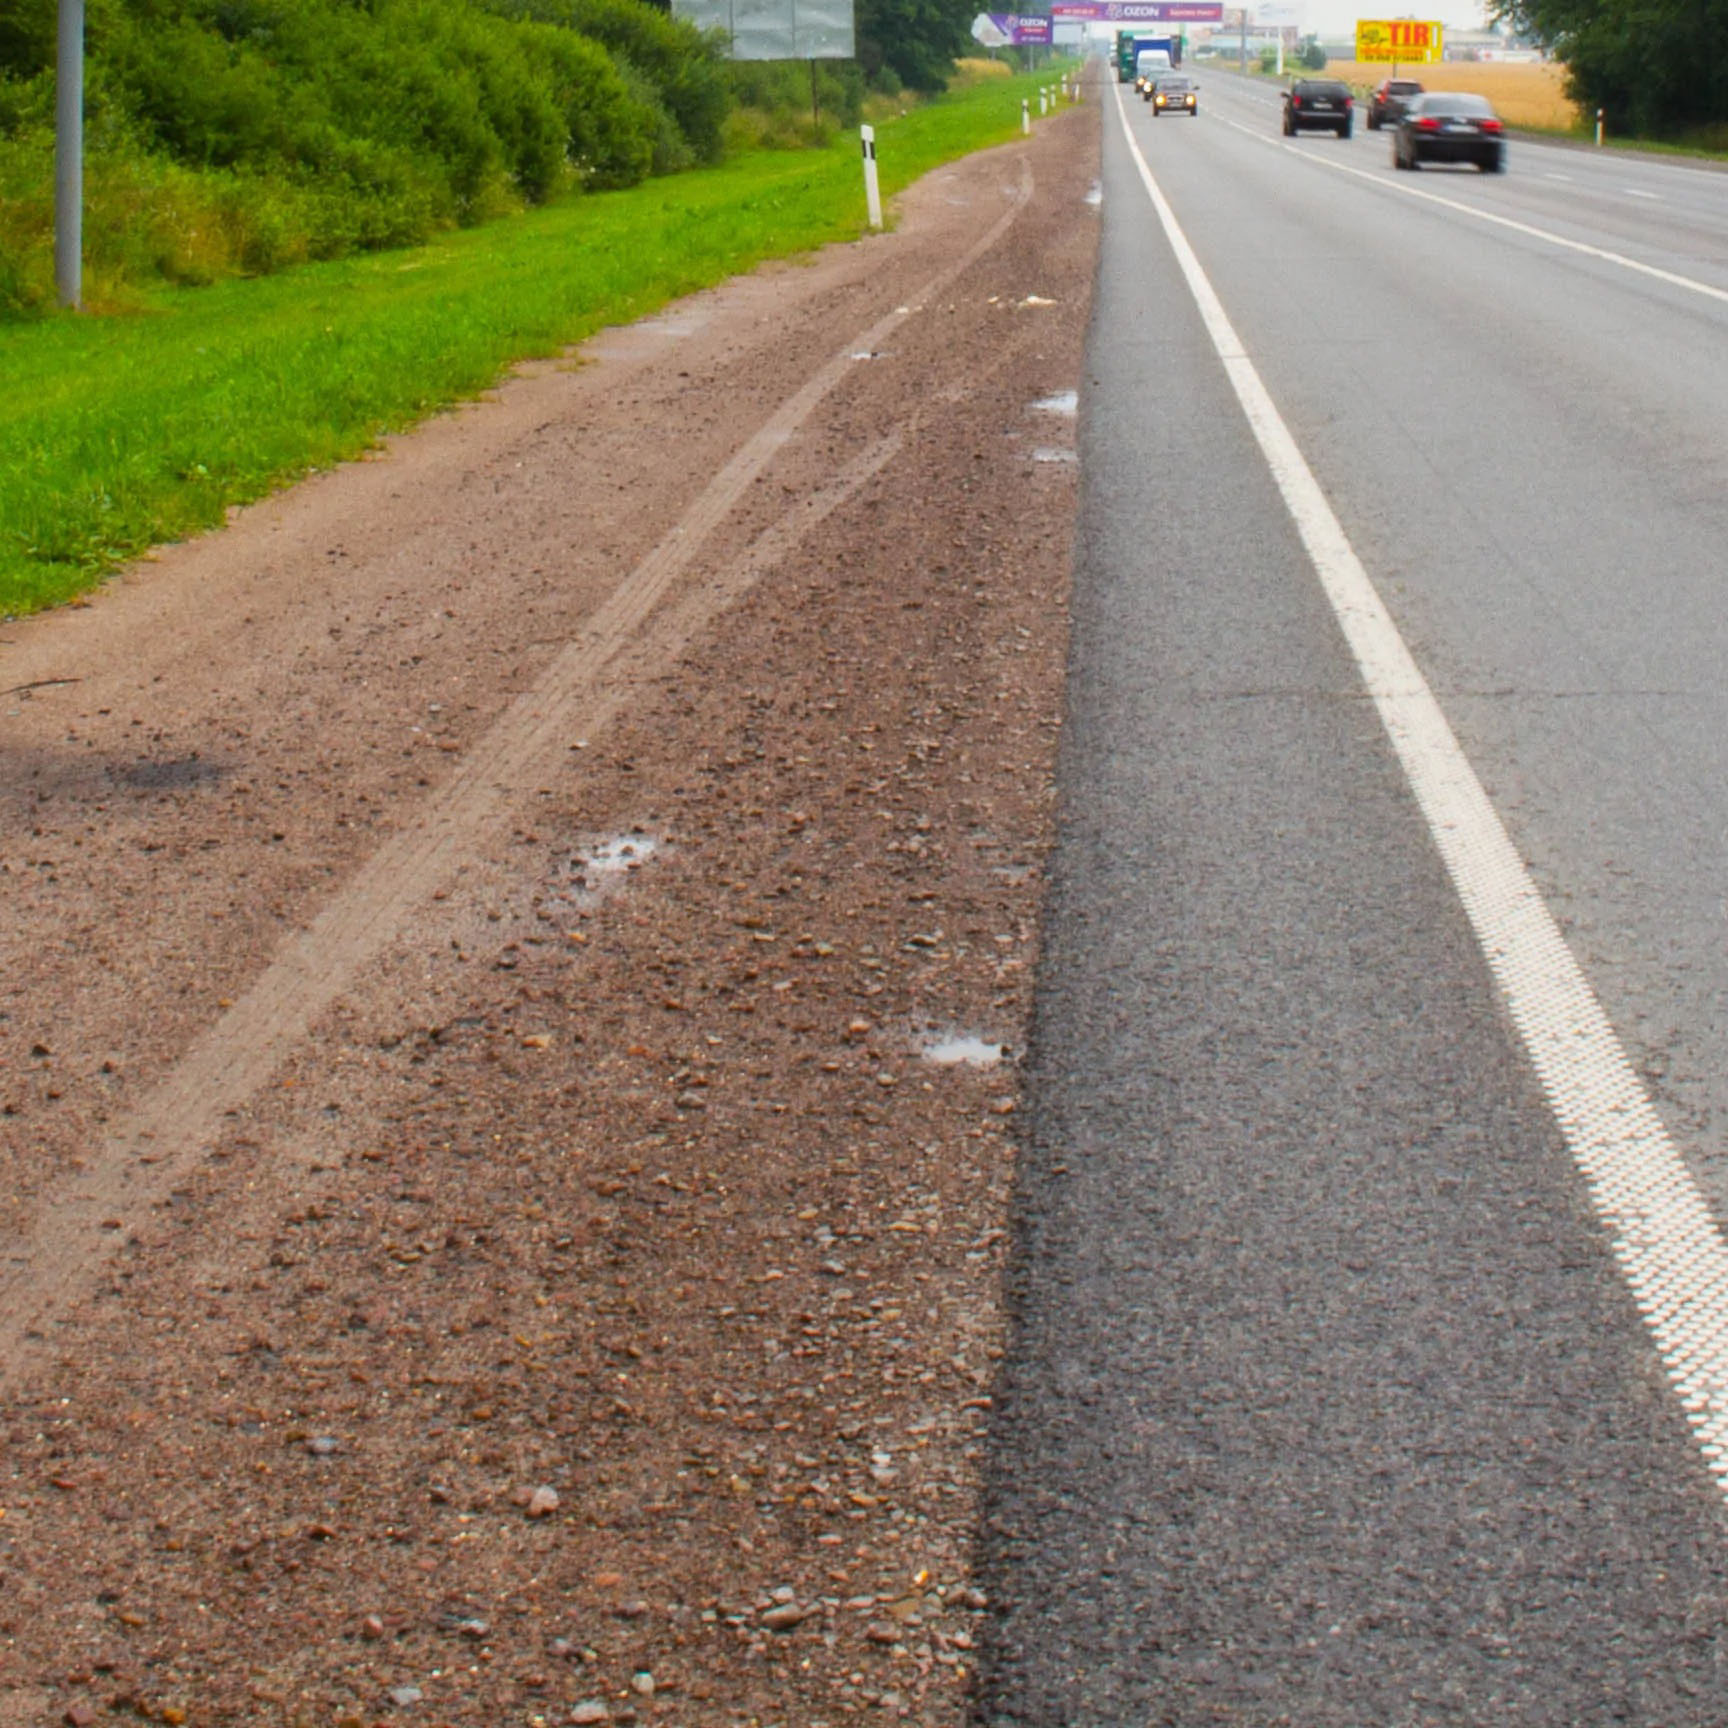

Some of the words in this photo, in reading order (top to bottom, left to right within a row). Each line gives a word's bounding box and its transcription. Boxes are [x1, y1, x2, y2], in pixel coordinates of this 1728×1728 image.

[1123, 5, 1160, 18] OZON
[1019, 17, 1048, 28] OZON
[1388, 23, 1428, 47] TIR
